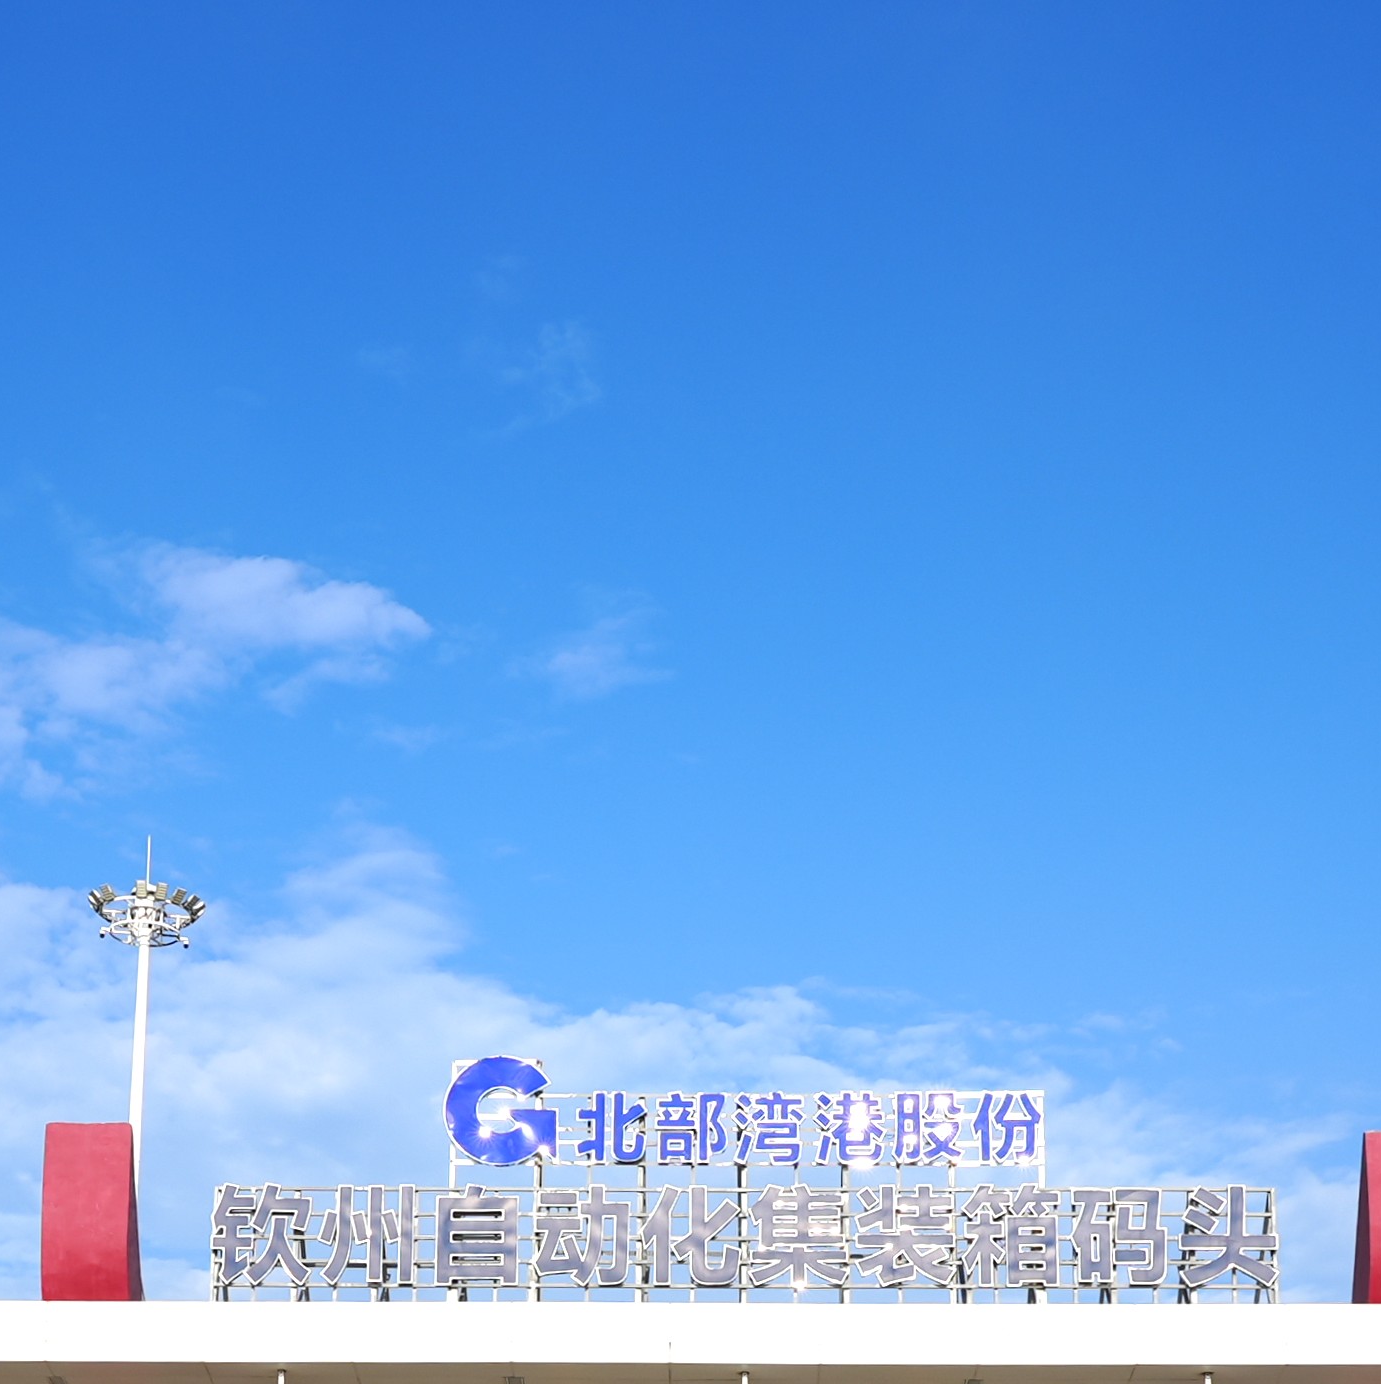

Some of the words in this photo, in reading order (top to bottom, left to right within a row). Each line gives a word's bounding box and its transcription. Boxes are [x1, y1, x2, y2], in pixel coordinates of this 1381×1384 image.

[576, 1090, 1042, 1167] 北部湾港股份
[210, 1182, 1280, 1288] 钦州自动化集装箱码头
